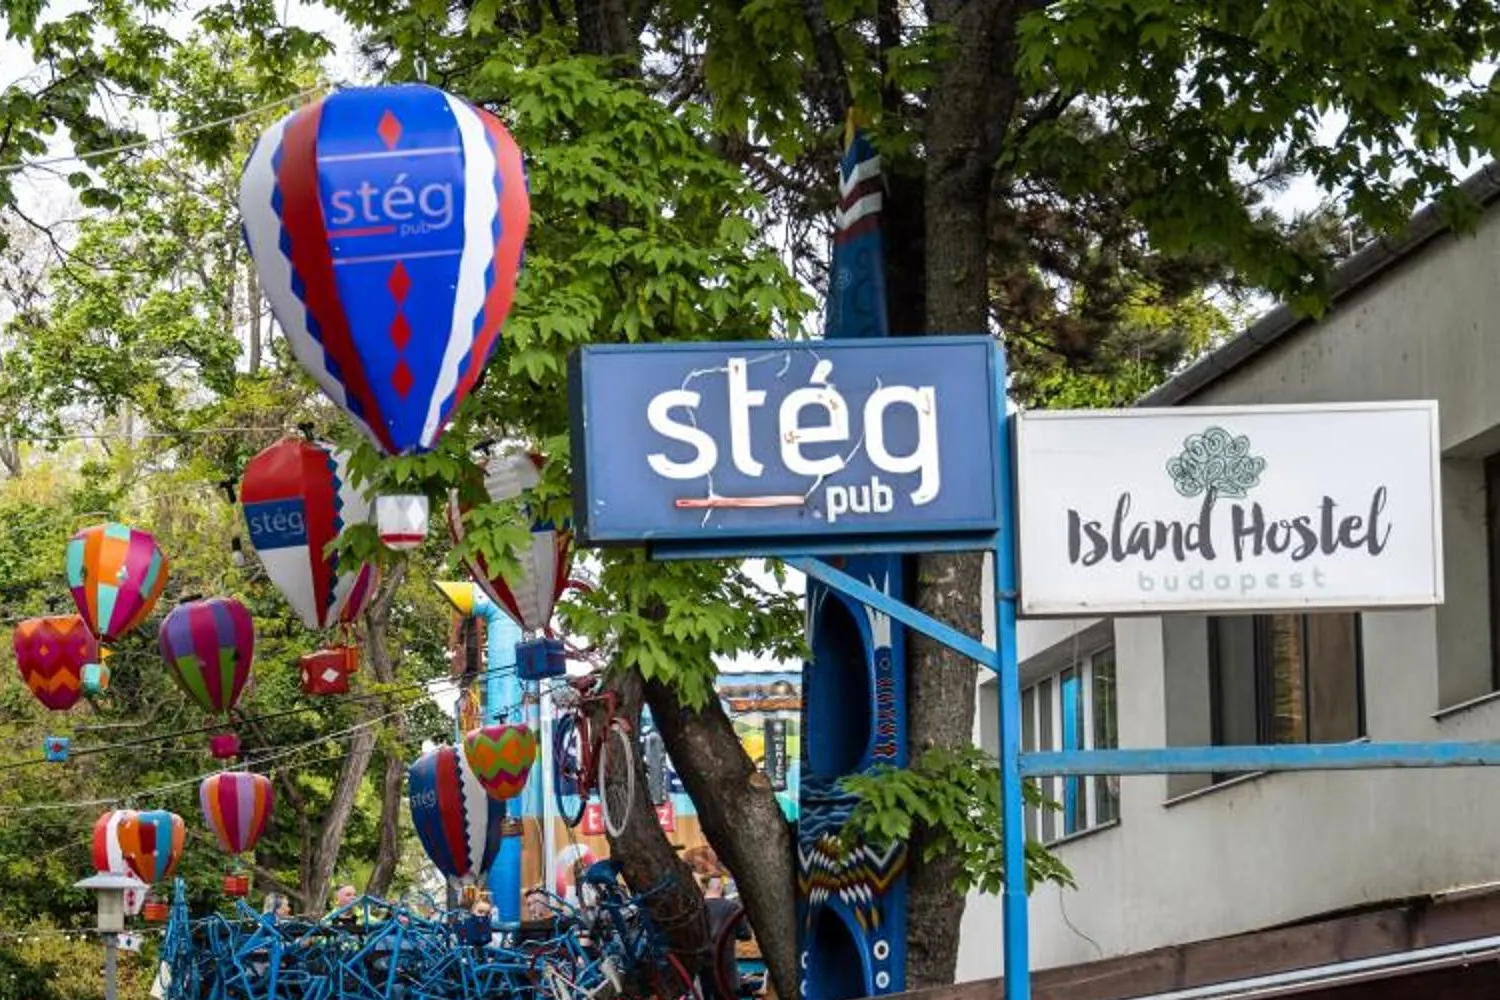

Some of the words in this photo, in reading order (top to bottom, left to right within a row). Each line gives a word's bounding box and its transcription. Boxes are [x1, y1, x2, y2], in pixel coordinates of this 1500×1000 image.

[330, 173, 454, 229] stég
[647, 357, 941, 505] stég
[251, 507, 304, 535] stég
[826, 476, 894, 522] pub
[1067, 490, 1216, 566] Island
[1231, 485, 1392, 562] Hostel
[1138, 567, 1326, 595] budapest
